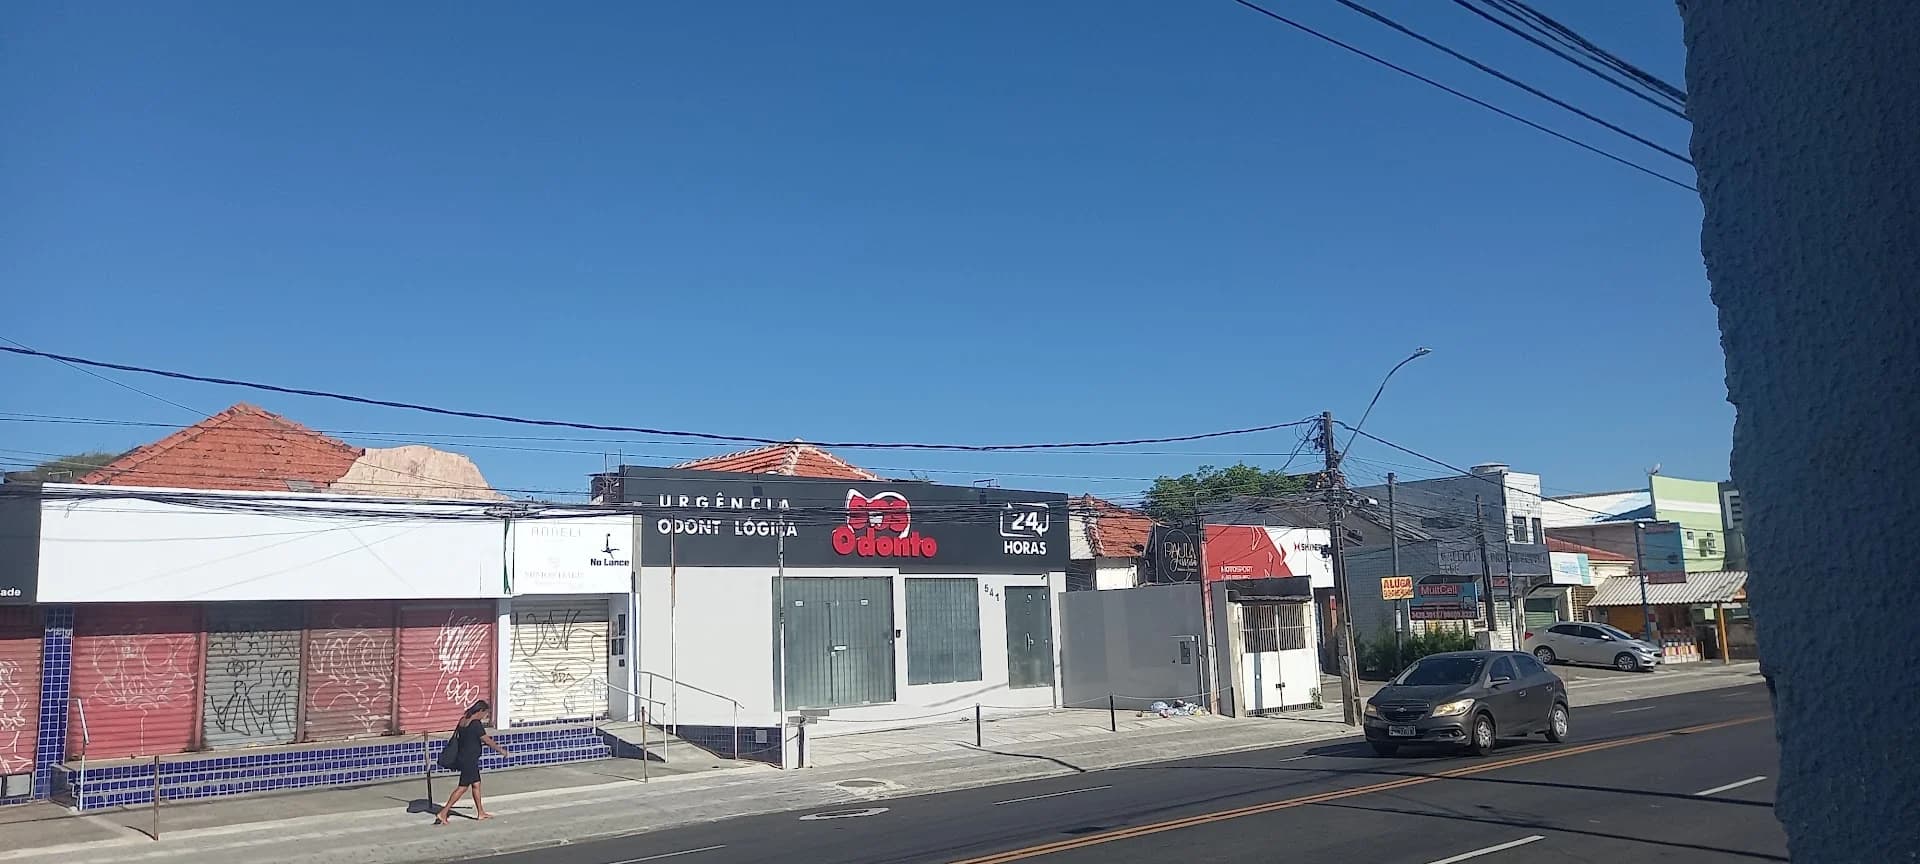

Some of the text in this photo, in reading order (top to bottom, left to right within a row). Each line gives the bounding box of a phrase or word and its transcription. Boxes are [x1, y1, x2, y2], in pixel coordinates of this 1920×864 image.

[658, 492, 790, 511] URGÊNCIA
[1011, 511, 1040, 531] 24
[832, 526, 938, 558] Odonto
[1003, 540, 1047, 555] HORAS
[590, 558, 630, 567] No Lance
[1383, 577, 1412, 589] ALUGA
[0, 587, 21, 597] ade
[984, 584, 1000, 602] 541
